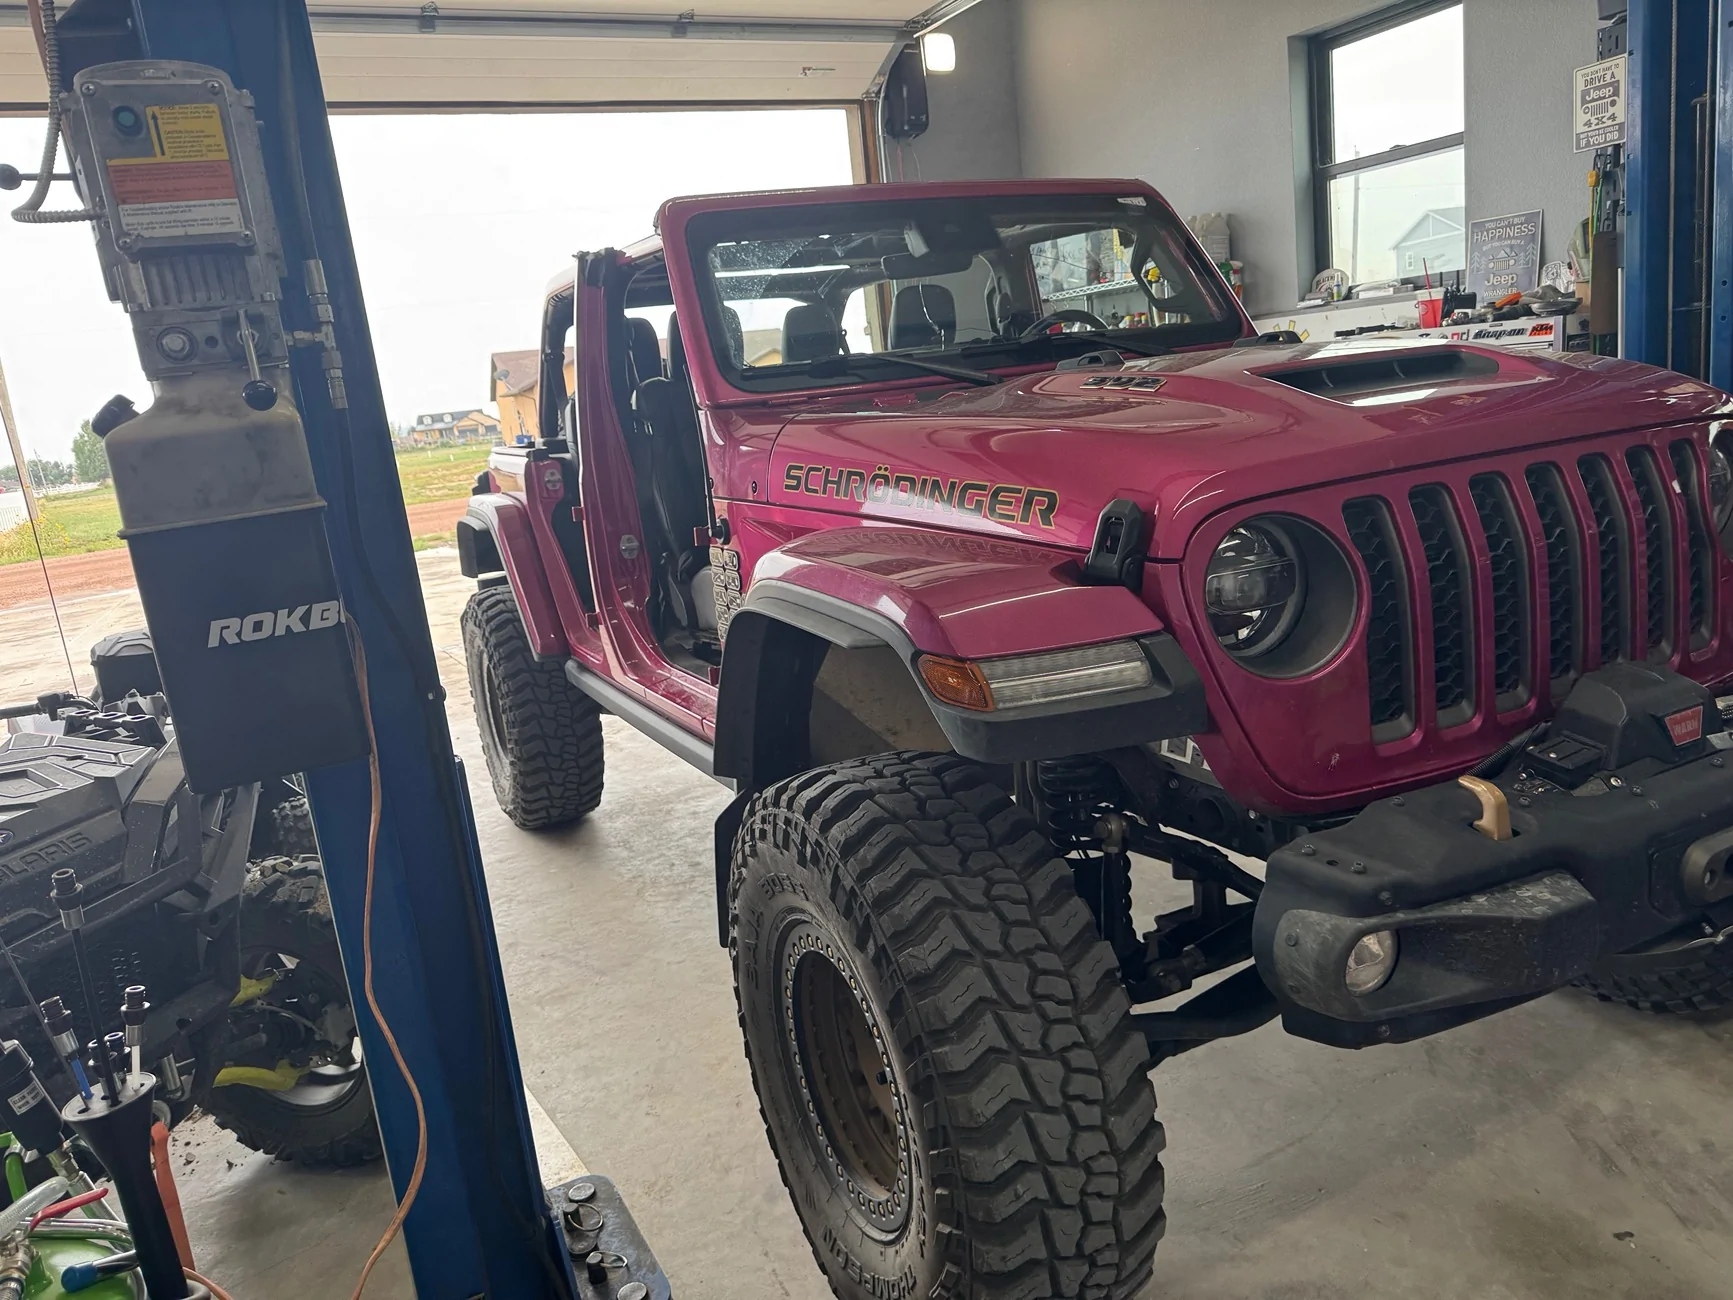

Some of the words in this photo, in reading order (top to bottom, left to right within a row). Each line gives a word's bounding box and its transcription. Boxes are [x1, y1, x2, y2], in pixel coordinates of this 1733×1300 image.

[1581, 71, 1589, 79] YOU
[1602, 65, 1613, 73] HAVE
[1584, 73, 1607, 88] DRIVE
[1610, 71, 1616, 80] A
[1585, 86, 1613, 101] Jeep
[1604, 125, 1619, 133] COOLER
[1580, 138, 1588, 148] IF
[1588, 134, 1605, 145] YOU
[1606, 131, 1619, 141] DID
[1496, 218, 1513, 226] CAN'T
[1473, 223, 1536, 243] HAPPINESS
[1484, 273, 1517, 286] Jeep
[1484, 287, 1517, 297] WRANGLER
[1080, 376, 1167, 393] 392
[783, 464, 1060, 530] SCHRÖDINGER
[1672, 718, 1699, 736] WARN
[0, 832, 94, 880] LARIS
